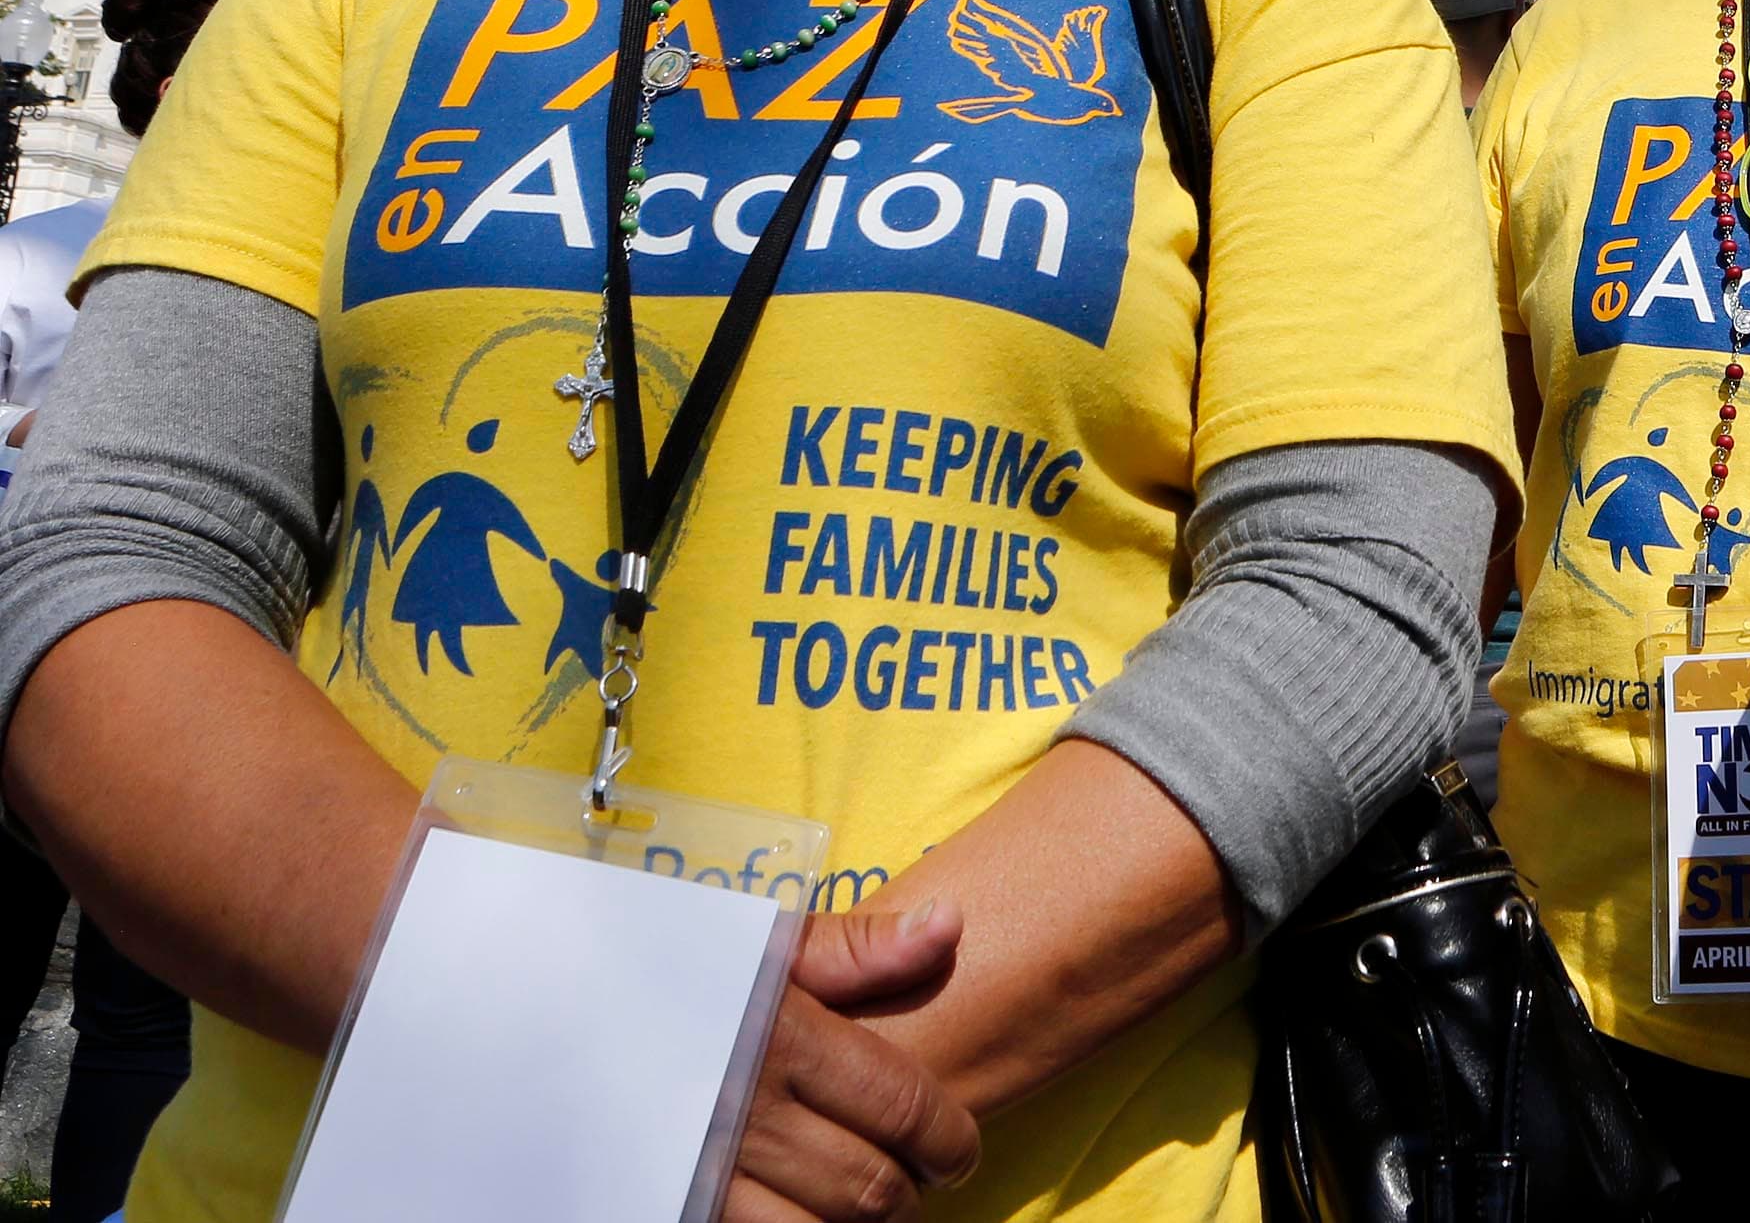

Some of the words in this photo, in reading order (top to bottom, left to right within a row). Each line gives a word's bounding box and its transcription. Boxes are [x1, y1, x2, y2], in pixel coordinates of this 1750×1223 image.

[375, 129, 479, 254] en
[441, 124, 1071, 278] Acción
[1591, 237, 1640, 323] en
[780, 405, 1084, 518] KEEPING
[763, 511, 1061, 615] FAMILIES
[750, 621, 1097, 712] TOGETHER
[1527, 659, 1664, 718] Immigrat
[1700, 822, 1722, 833] ALL
[1726, 821, 1739, 831] IN
